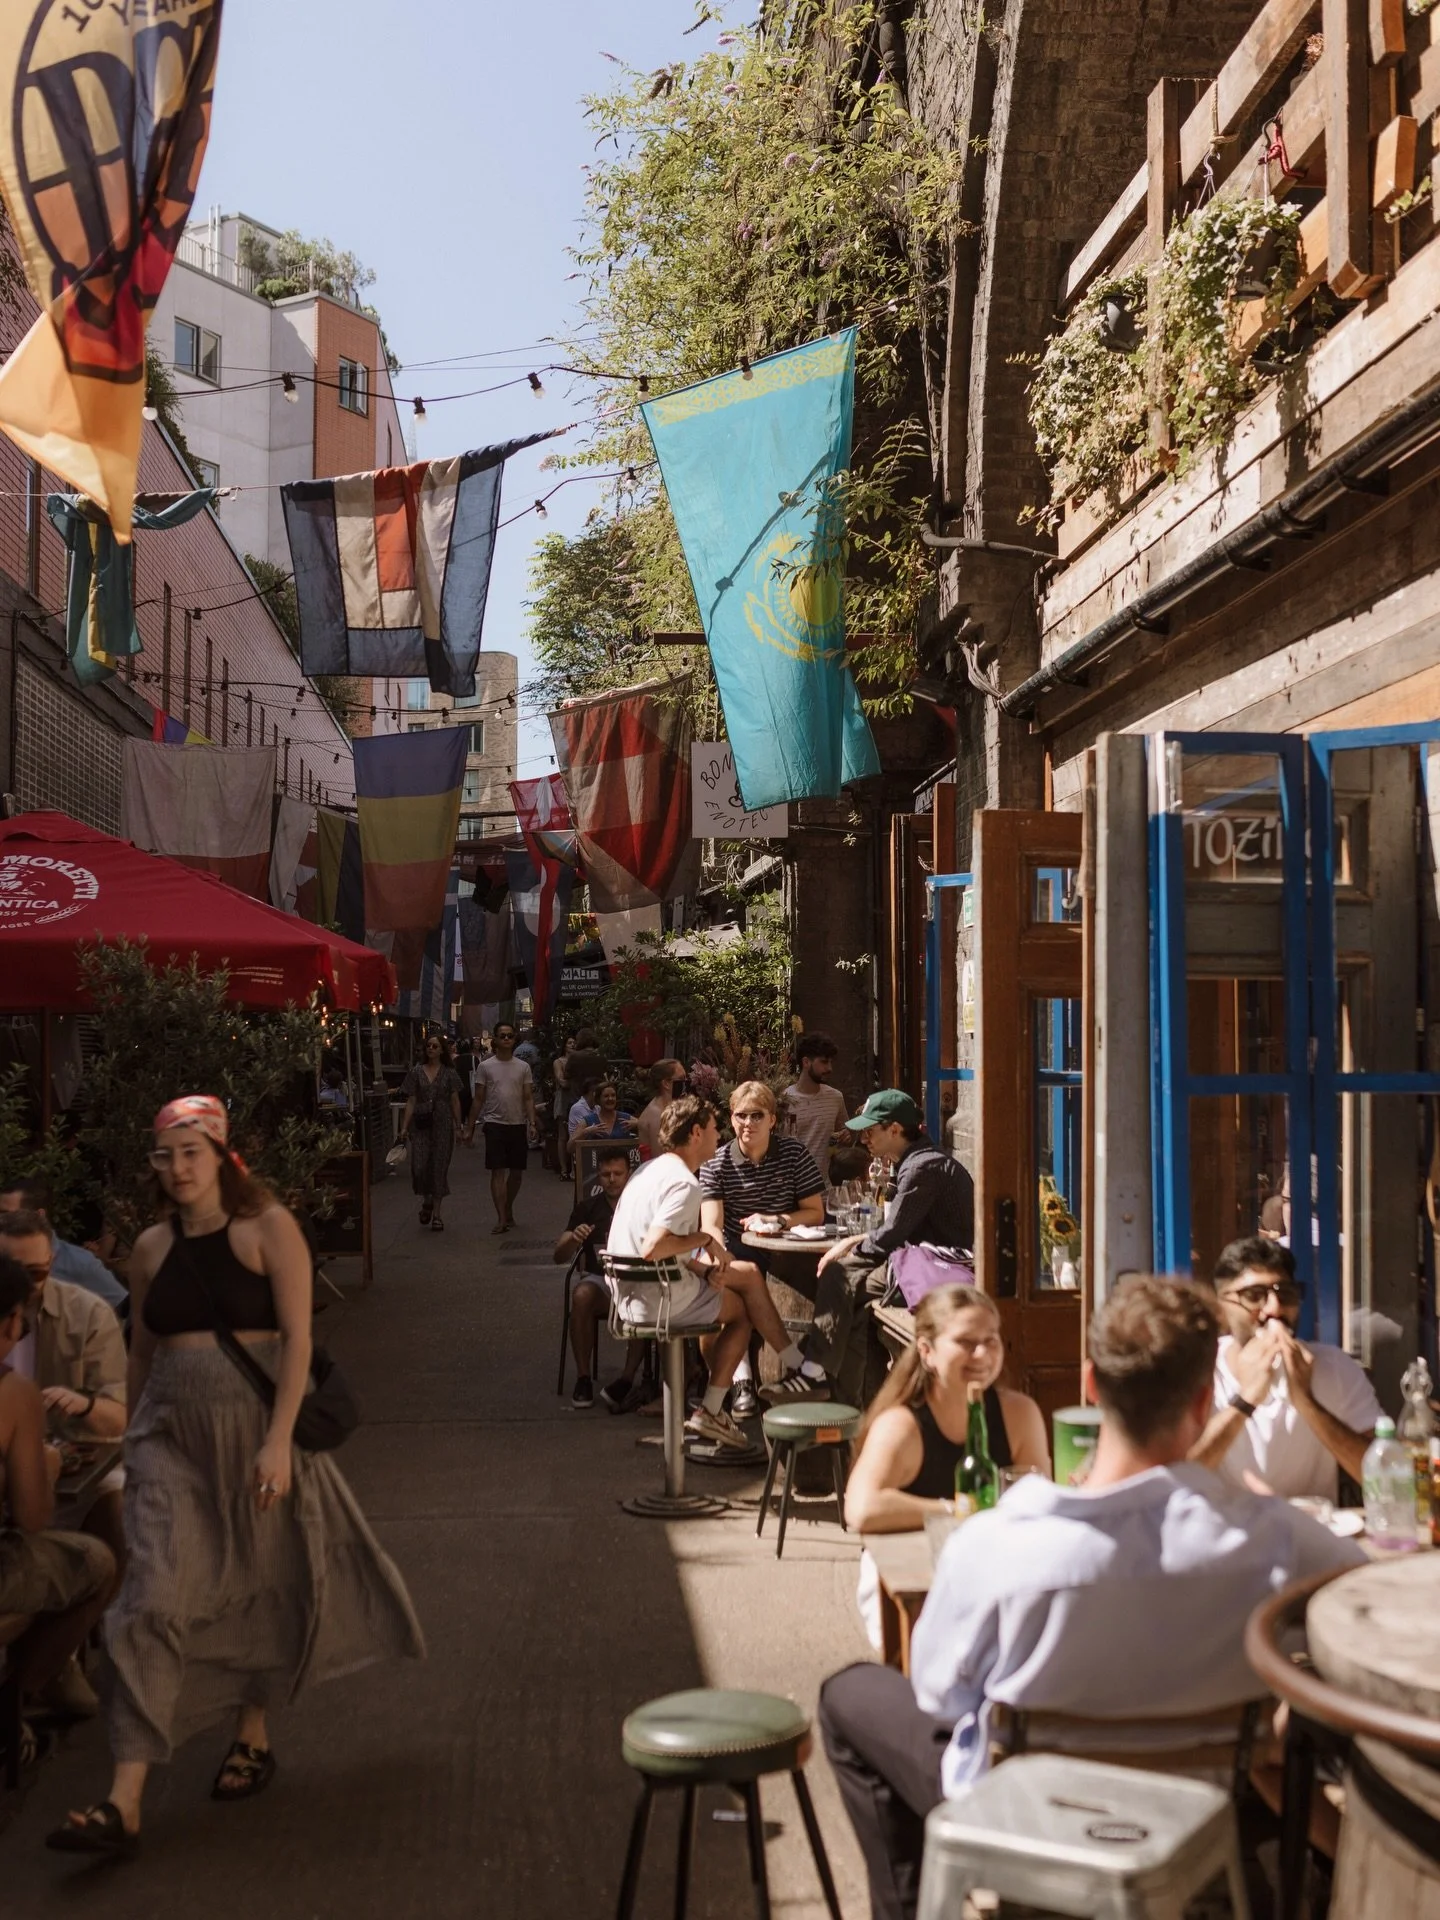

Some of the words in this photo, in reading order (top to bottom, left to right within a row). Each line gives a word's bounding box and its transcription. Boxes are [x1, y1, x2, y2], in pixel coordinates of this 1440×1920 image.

[109, 0, 196, 26] YEA
[704, 801, 774, 832] ENOTEC
[1, 855, 99, 899] MORETTI
